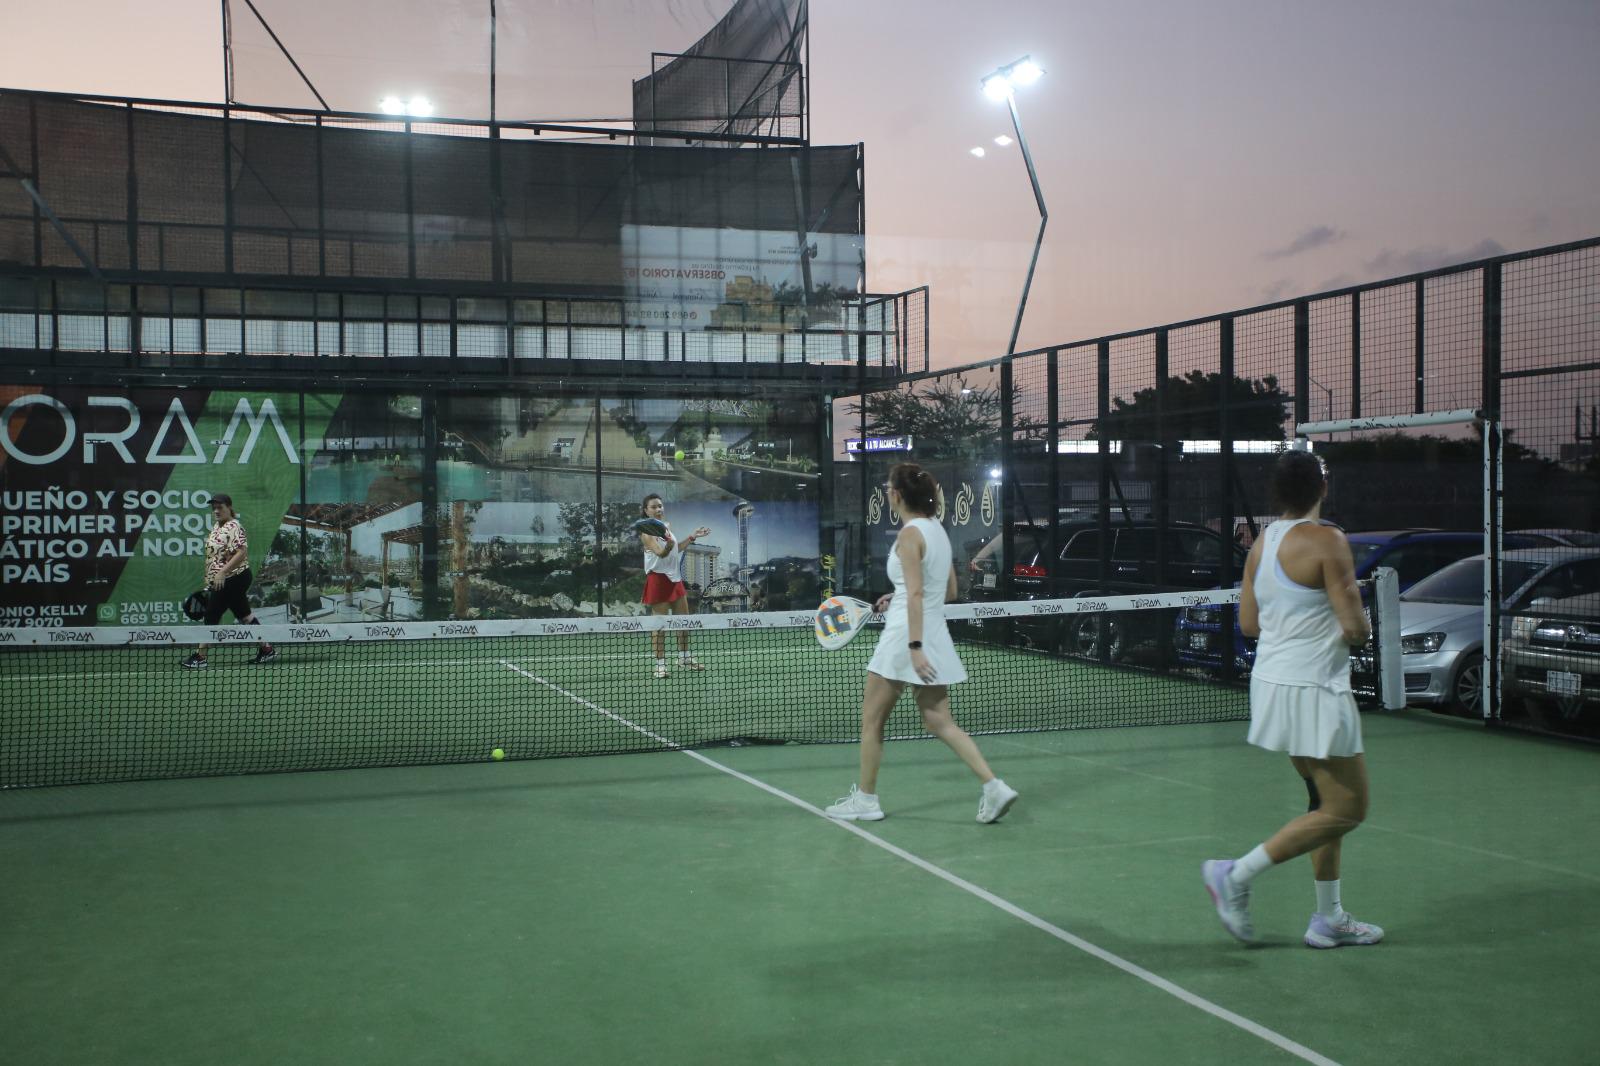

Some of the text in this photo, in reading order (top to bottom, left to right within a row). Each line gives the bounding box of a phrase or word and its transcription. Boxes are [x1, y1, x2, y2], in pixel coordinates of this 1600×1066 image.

[0, 486, 212, 510] UEÑO Y SOCIO
[3, 514, 213, 536] PRIMER PARQ
[0, 535, 207, 558] ÁTICO AL NOR
[3, 559, 70, 583] PAÍS
[40, 604, 88, 616] KELLY
[120, 601, 173, 612] JAVIER
[0, 617, 63, 628] 27 9070
[120, 613, 147, 624] 669
[152, 612, 178, 623] 993
[789, 614, 816, 625] TORA
